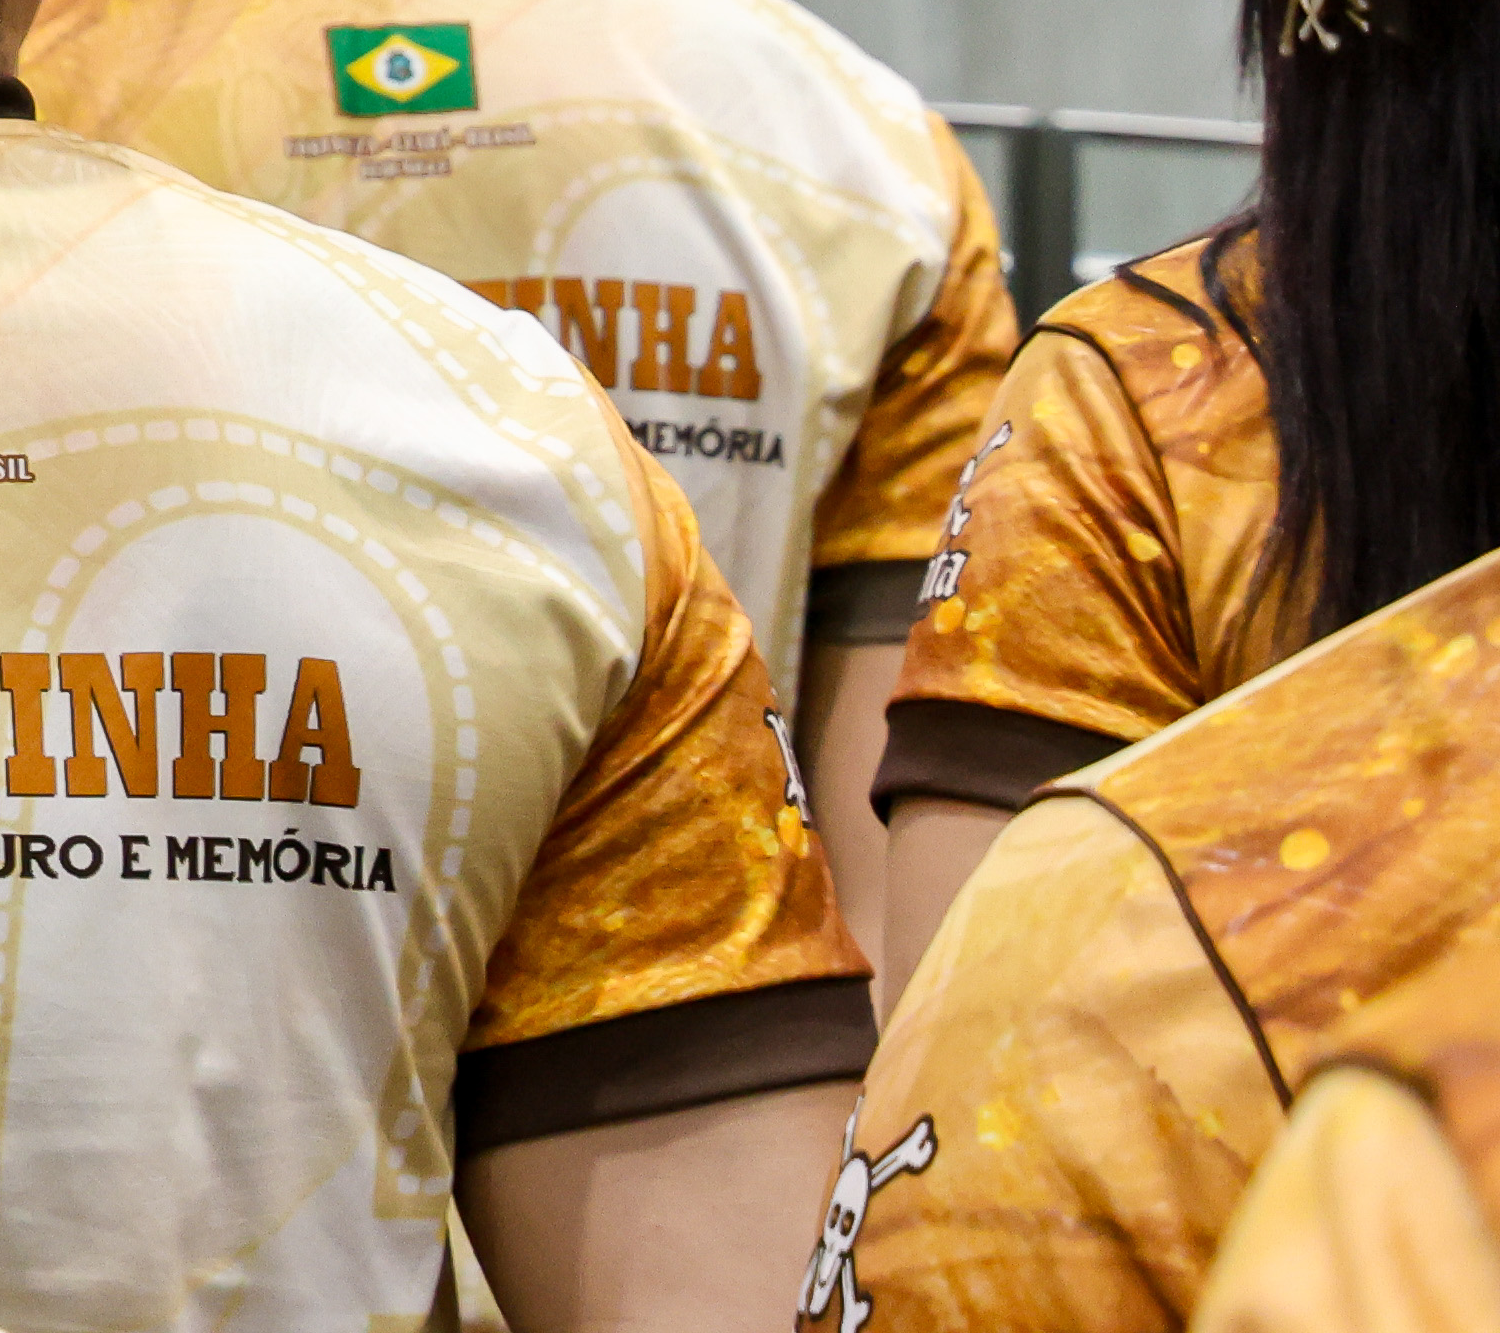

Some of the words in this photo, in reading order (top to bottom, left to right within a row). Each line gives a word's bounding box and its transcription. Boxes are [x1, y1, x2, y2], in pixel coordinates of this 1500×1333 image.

[460, 276, 760, 400] NHA
[120, 835, 150, 880] E
[166, 829, 397, 893] MEMÓRIA
